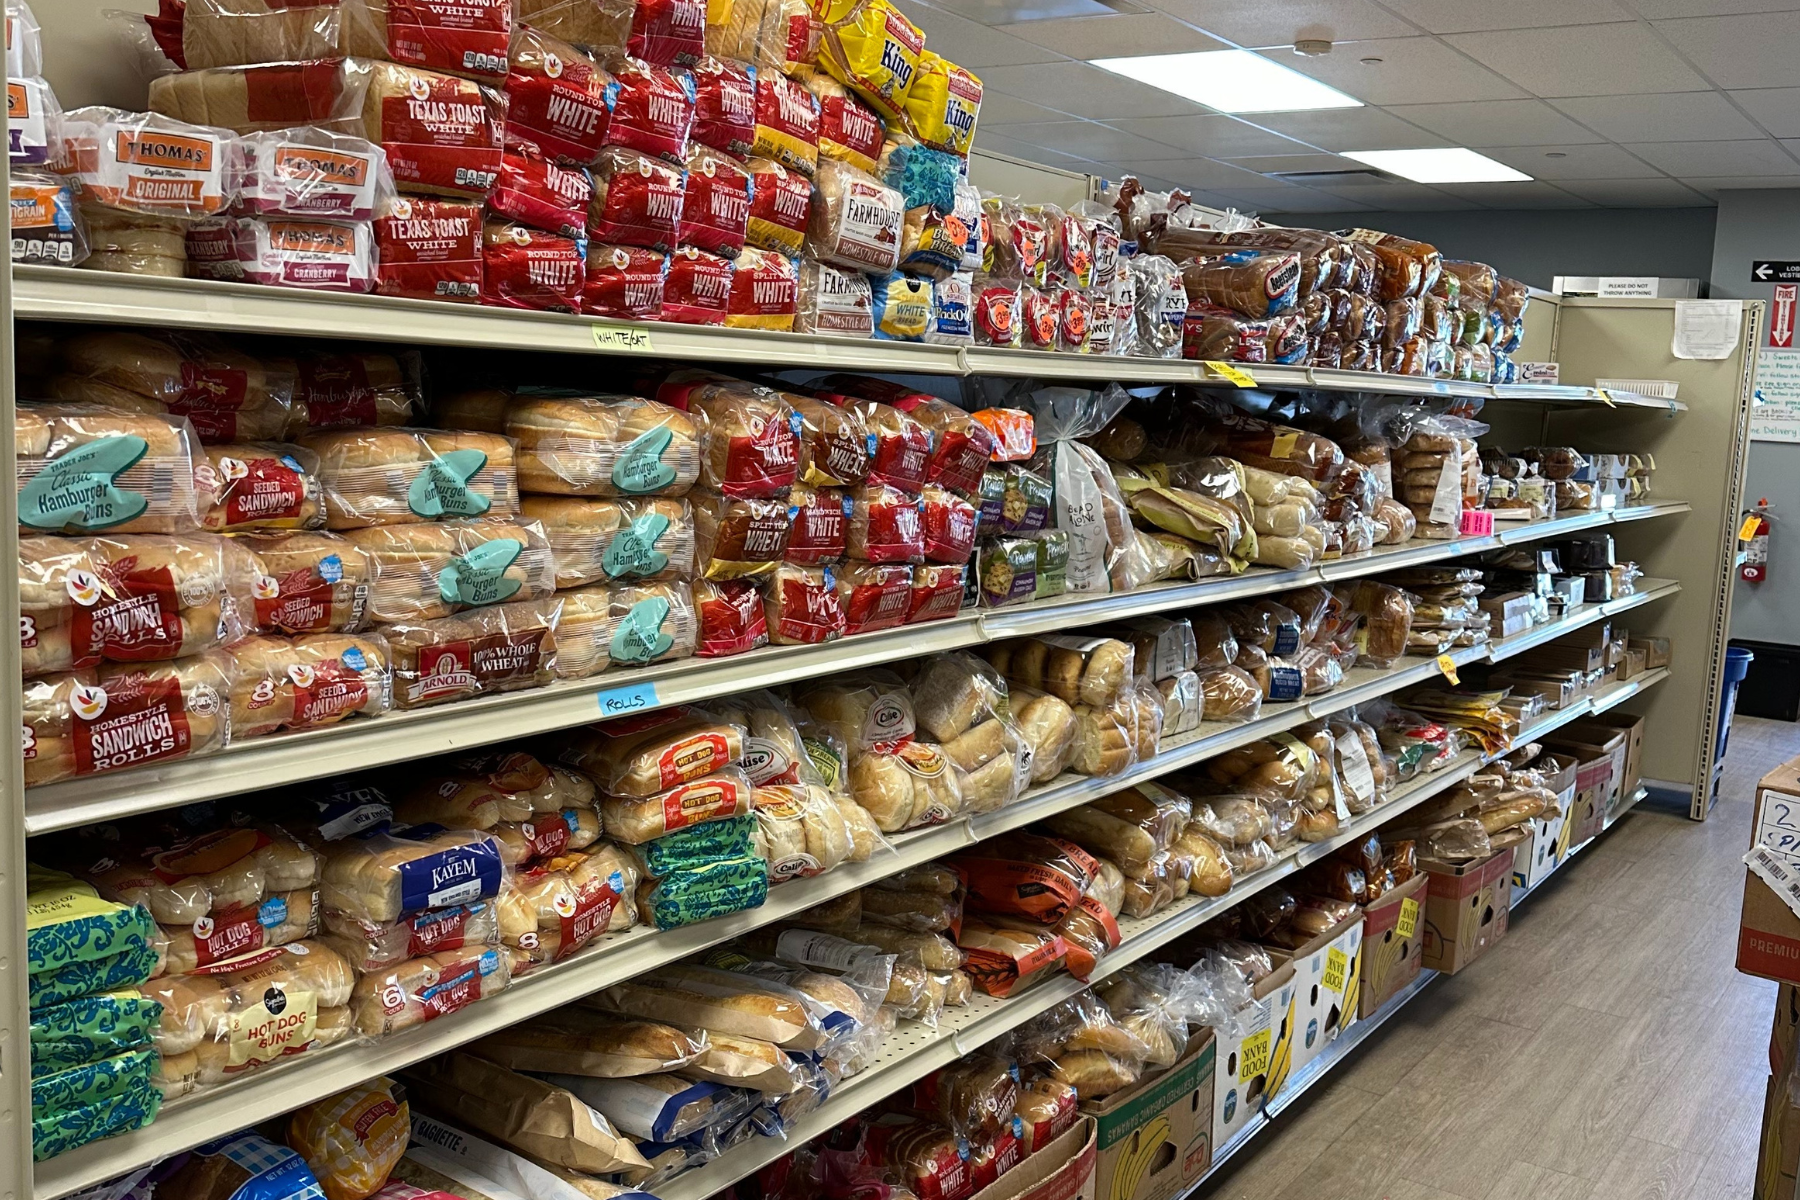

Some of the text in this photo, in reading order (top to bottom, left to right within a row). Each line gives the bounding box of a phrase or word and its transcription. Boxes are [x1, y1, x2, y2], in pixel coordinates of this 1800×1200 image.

[429, 5, 484, 17] WHITE
[880, 40, 914, 90] King
[553, 84, 605, 108] ROUND TOP
[720, 89, 753, 115] WHITE
[407, 100, 486, 124] TEXAS TOAST
[547, 94, 602, 135] WHITE
[649, 95, 686, 127] WHITE
[944, 99, 976, 139] King
[424, 124, 475, 135] WHITE
[842, 111, 876, 145] WHITE
[136, 180, 196, 199] ORIGINAL
[648, 183, 672, 192] ROUND
[712, 183, 748, 197] ROUND TOP
[711, 192, 748, 222] WHITE
[774, 189, 809, 220] WHITE
[847, 199, 901, 231] FARMHOUSE
[388, 218, 469, 240] TEXAS TOAST
[406, 240, 457, 250] WHITE
[527, 251, 577, 259] ROUND TOP
[841, 241, 892, 266] HOMESTYLE OAT
[294, 267, 337, 279] CRANBERRY
[528, 261, 578, 285] WHITE
[695, 265, 720, 275] ROUND
[692, 274, 730, 299] WHITE
[753, 281, 791, 304] WHITE
[1778, 290, 1794, 299] FIRE
[897, 304, 925, 317] WHITE
[822, 315, 859, 329] HOMESTYLE
[597, 330, 648, 350] WHITE/OAT
[1764, 427, 1797, 437] Delivery
[51, 452, 97, 473] TRADER JOE'S
[623, 462, 658, 479] Hamburger
[827, 446, 867, 475] WHEAT
[902, 449, 926, 472] WHITE
[959, 449, 987, 472] WHITE
[51, 470, 93, 491] Classic
[253, 482, 281, 493] SEEDED
[643, 474, 660, 488] Buns
[38, 483, 109, 514] Hamburger
[238, 491, 296, 512] SANDWICH
[424, 482, 466, 504] Hamburger
[440, 496, 468, 511] Buns
[83, 502, 113, 523] Buns
[749, 521, 773, 529] SPLIT
[808, 517, 841, 537] WHITE
[744, 530, 784, 552] WHEAT
[284, 597, 311, 613] SEEDED
[472, 587, 498, 602] Buns
[878, 591, 908, 613] WHITE
[929, 590, 961, 610] WHITE
[91, 593, 158, 621] HOMESTYLE
[91, 602, 163, 642] SANDWICH
[473, 643, 536, 663] 100% WHOLE
[402, 660, 408, 671] 8
[481, 657, 526, 672] WHEAT
[252, 680, 275, 702] 8
[319, 683, 347, 699] SEEDED
[422, 674, 468, 690] ARNOLD
[303, 688, 365, 719] SANDWICH
[606, 695, 646, 710] ROLLS
[89, 702, 167, 735] HOMESTYLE
[90, 711, 174, 760] SANDWICH
[93, 737, 176, 772] ROLLS
[677, 748, 714, 767] HOT DOG
[683, 763, 711, 781] BUNS
[439, 781, 459, 798] 8
[684, 793, 722, 809] HOT DOG
[354, 813, 371, 824] NEW
[688, 810, 715, 823] BUNS
[1774, 803, 1796, 828] 2
[546, 829, 564, 842] DOG
[1068, 846, 1099, 876] BREAD
[432, 858, 477, 890] KAYEM
[1030, 866, 1054, 879] FRESH
[1055, 876, 1073, 892] DAILY
[575, 898, 611, 923] HOMESTYLE
[1402, 907, 1415, 921] BANK
[419, 916, 460, 941] HOT DOG
[573, 905, 611, 938] HOT DOG
[1399, 921, 1414, 934] FOOD
[208, 922, 252, 953] HOT DOG
[213, 938, 250, 957] ROLLS
[519, 933, 540, 949] 8
[220, 964, 234, 974] High
[235, 959, 257, 969] Fructose
[258, 955, 268, 963] Corn
[269, 950, 283, 961] Syrup
[1327, 957, 1344, 975] BANK
[1325, 972, 1343, 989] FOOD
[383, 986, 402, 1008] 6
[430, 993, 447, 1011] HOT
[452, 982, 469, 1000] DOG
[234, 1019, 240, 1029] 8
[248, 1012, 307, 1041] HOT DOG
[258, 1030, 294, 1049] BUNS
[1243, 1040, 1268, 1063] BANK
[1242, 1062, 1267, 1078] FOOD
[356, 1104, 389, 1132] GLUTEN FREE
[1108, 1078, 1194, 1142] CERTIFIED ORGANIC BANANAS
[1050, 1113, 1072, 1137] WHITE
[417, 1121, 463, 1151] BAGUETTE
[995, 1145, 1018, 1177] WHITE
[266, 1173, 276, 1182] NET
[940, 1167, 965, 1196] WHITE
